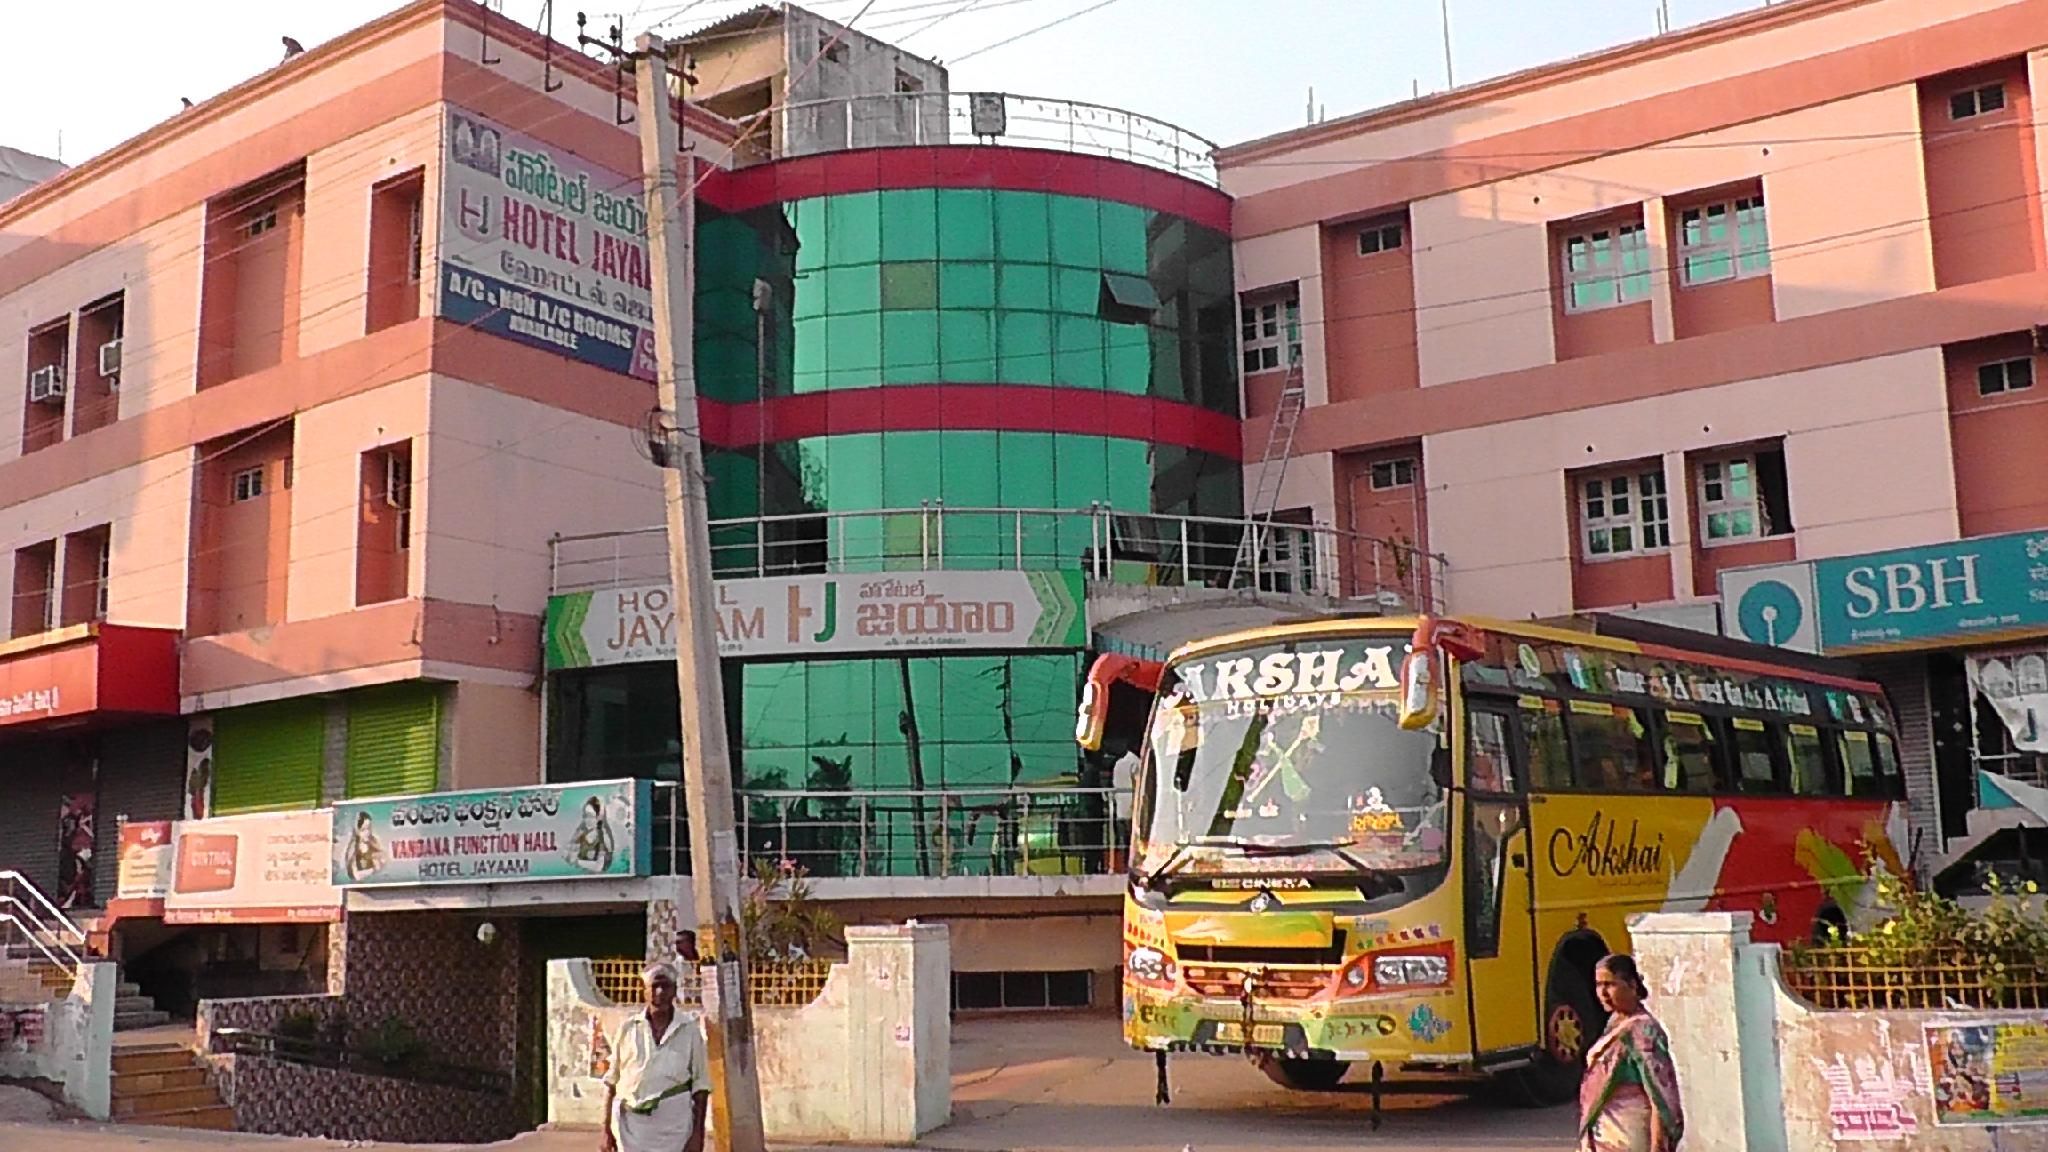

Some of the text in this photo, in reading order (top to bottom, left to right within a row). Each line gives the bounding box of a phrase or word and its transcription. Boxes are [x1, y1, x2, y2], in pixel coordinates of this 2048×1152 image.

[503, 195, 581, 265] HOTEL
[449, 271, 485, 301] A/C
[499, 287, 536, 317] NON
[539, 300, 571, 329] A/C
[573, 312, 632, 349] ROOMS
[509, 314, 579, 350] AVAILABLE
[618, 585, 738, 613] HOL
[859, 578, 926, 600] హోటల్
[1845, 554, 1984, 619] SBH
[607, 607, 765, 650] JAYAM
[391, 831, 557, 860] VANDANA FUNCTION HALL
[1548, 810, 1664, 877] Akshai
[417, 858, 530, 877] HOTEL JAYAAM
